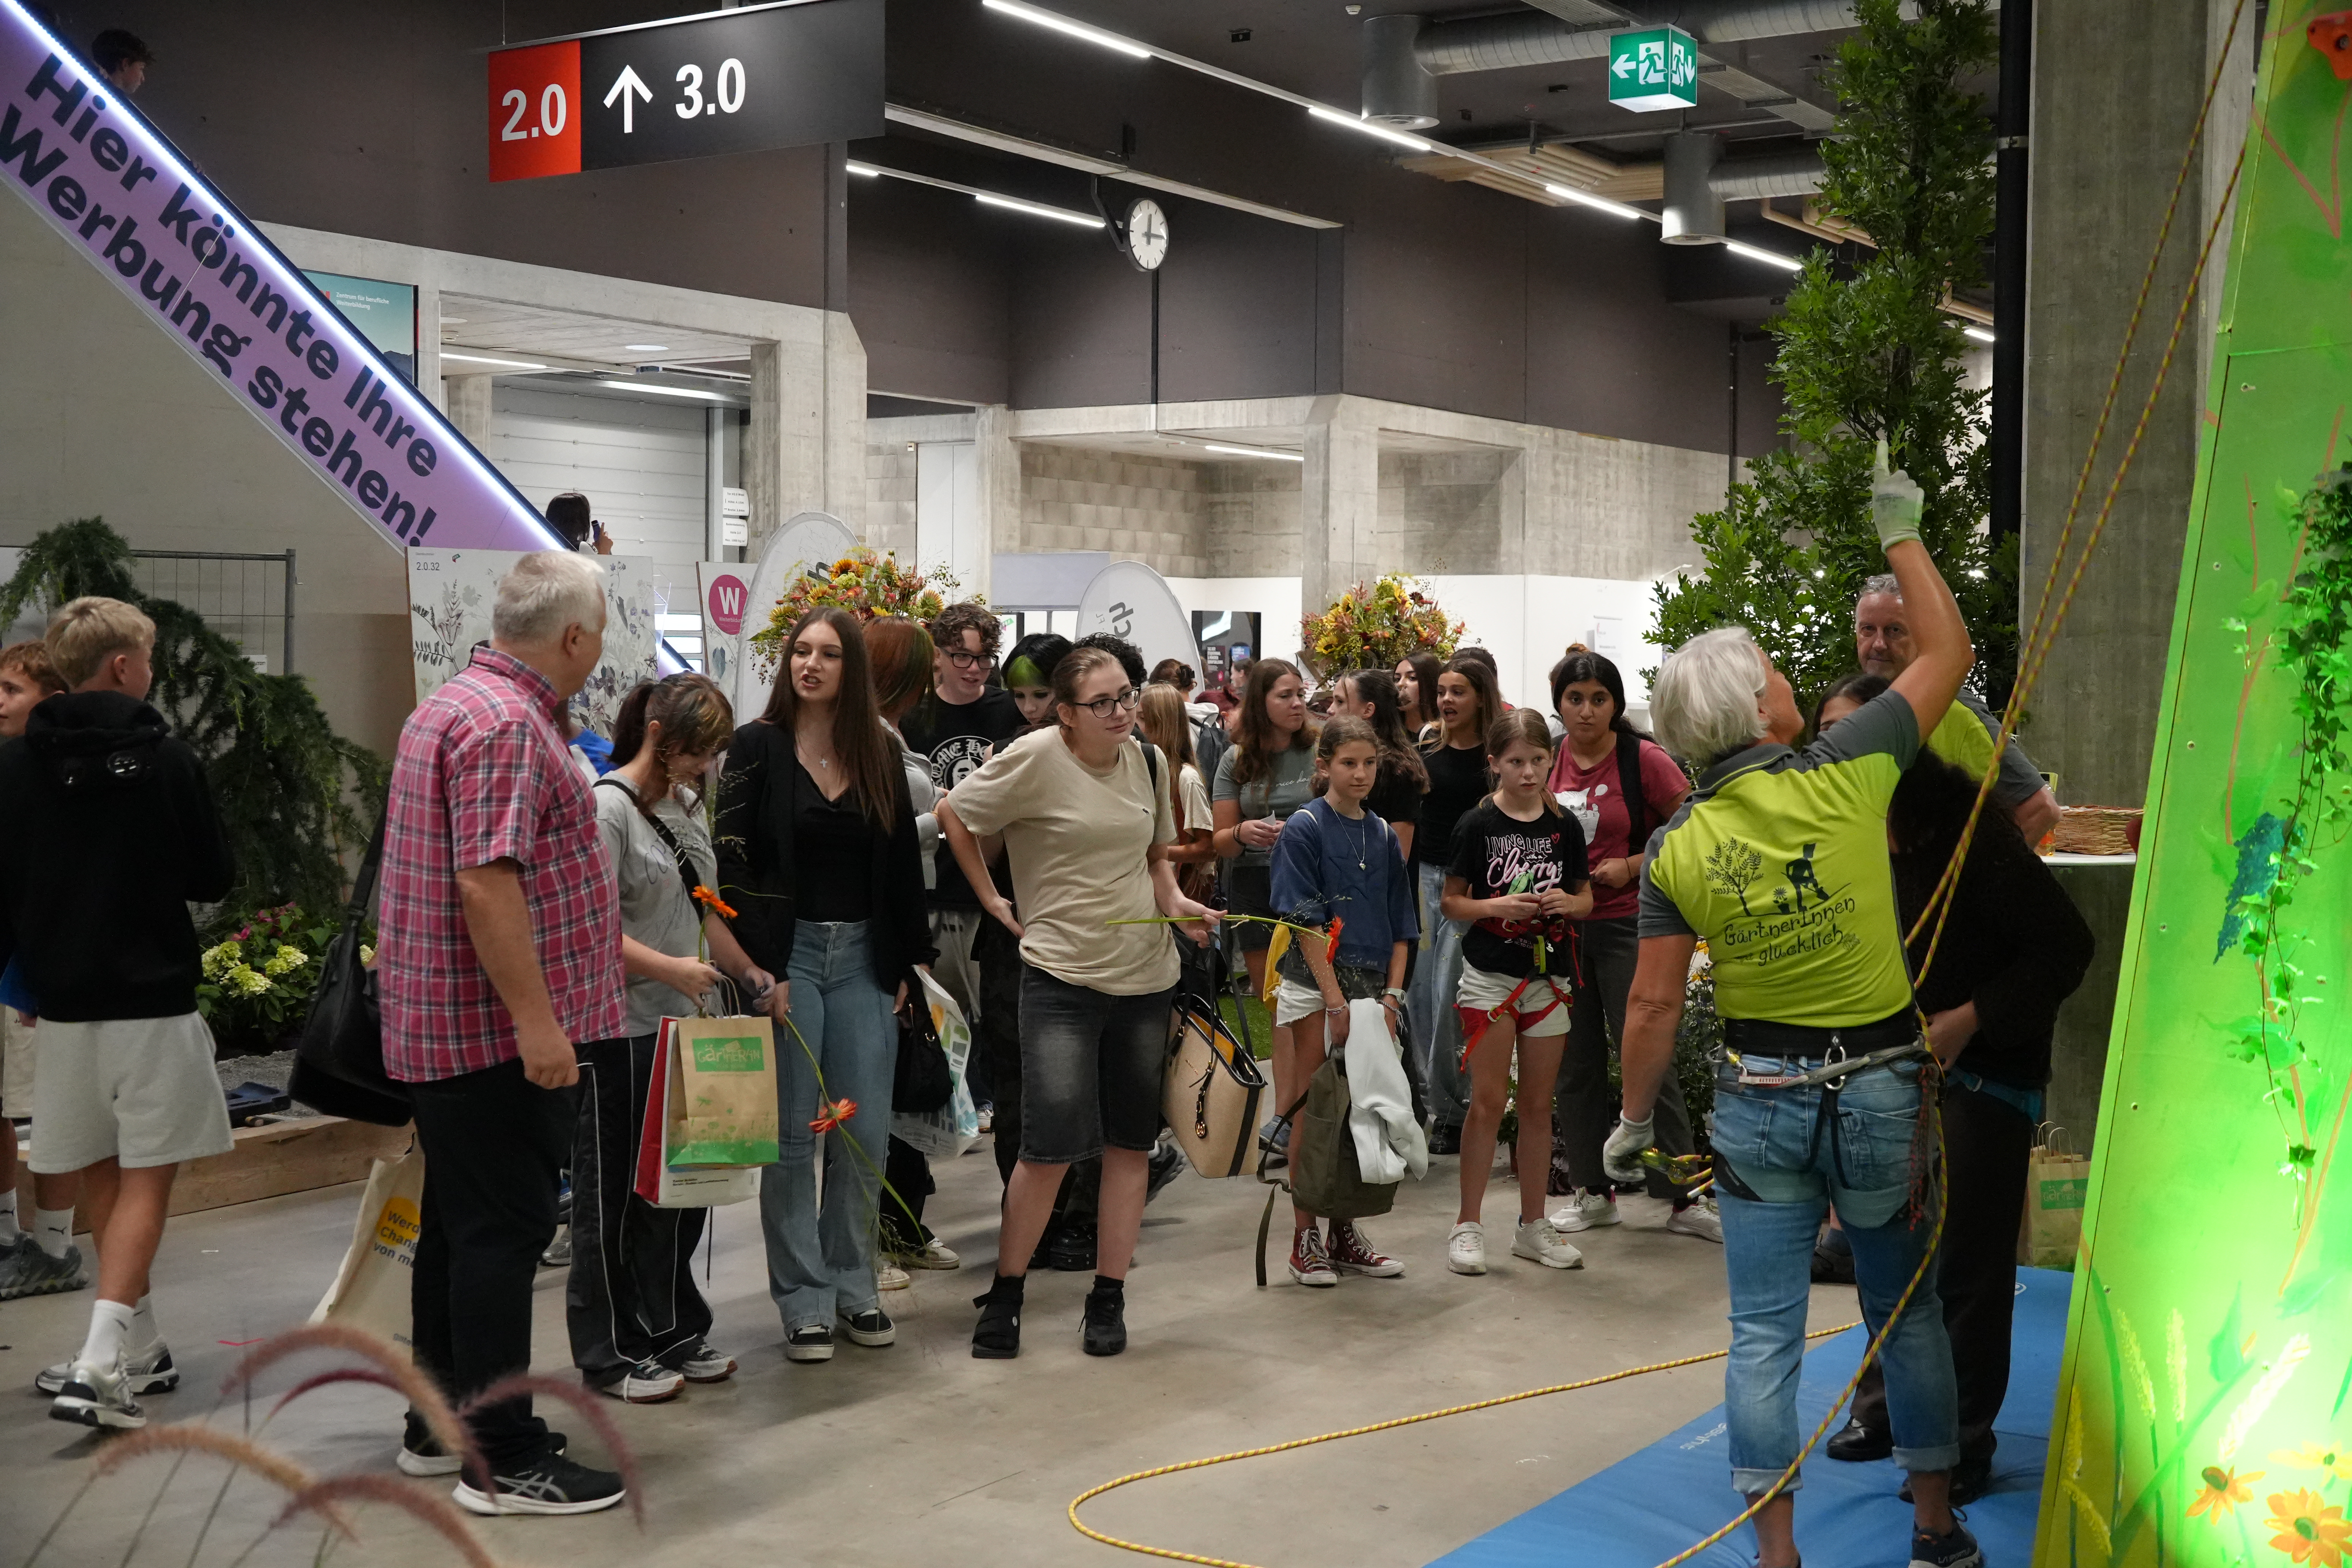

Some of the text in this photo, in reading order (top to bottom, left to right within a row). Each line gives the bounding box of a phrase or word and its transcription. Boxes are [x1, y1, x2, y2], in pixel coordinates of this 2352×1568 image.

[675, 58, 746, 119] 3.0
[501, 84, 566, 142] 2.0
[25, 53, 437, 477] Hier könnte Ihre
[336, 300, 370, 310] Weiterbildung
[366, 296, 389, 304] berufliche
[0, 103, 437, 547] Werbung stehen!
[417, 562, 440, 571] 2.0.32
[718, 586, 740, 615] W
[1485, 834, 1552, 863] LIVING LIFE
[1724, 898, 1855, 945] GärtnerInnen
[1758, 923, 1843, 967] glücklich
[374, 1241, 395, 1259] von
